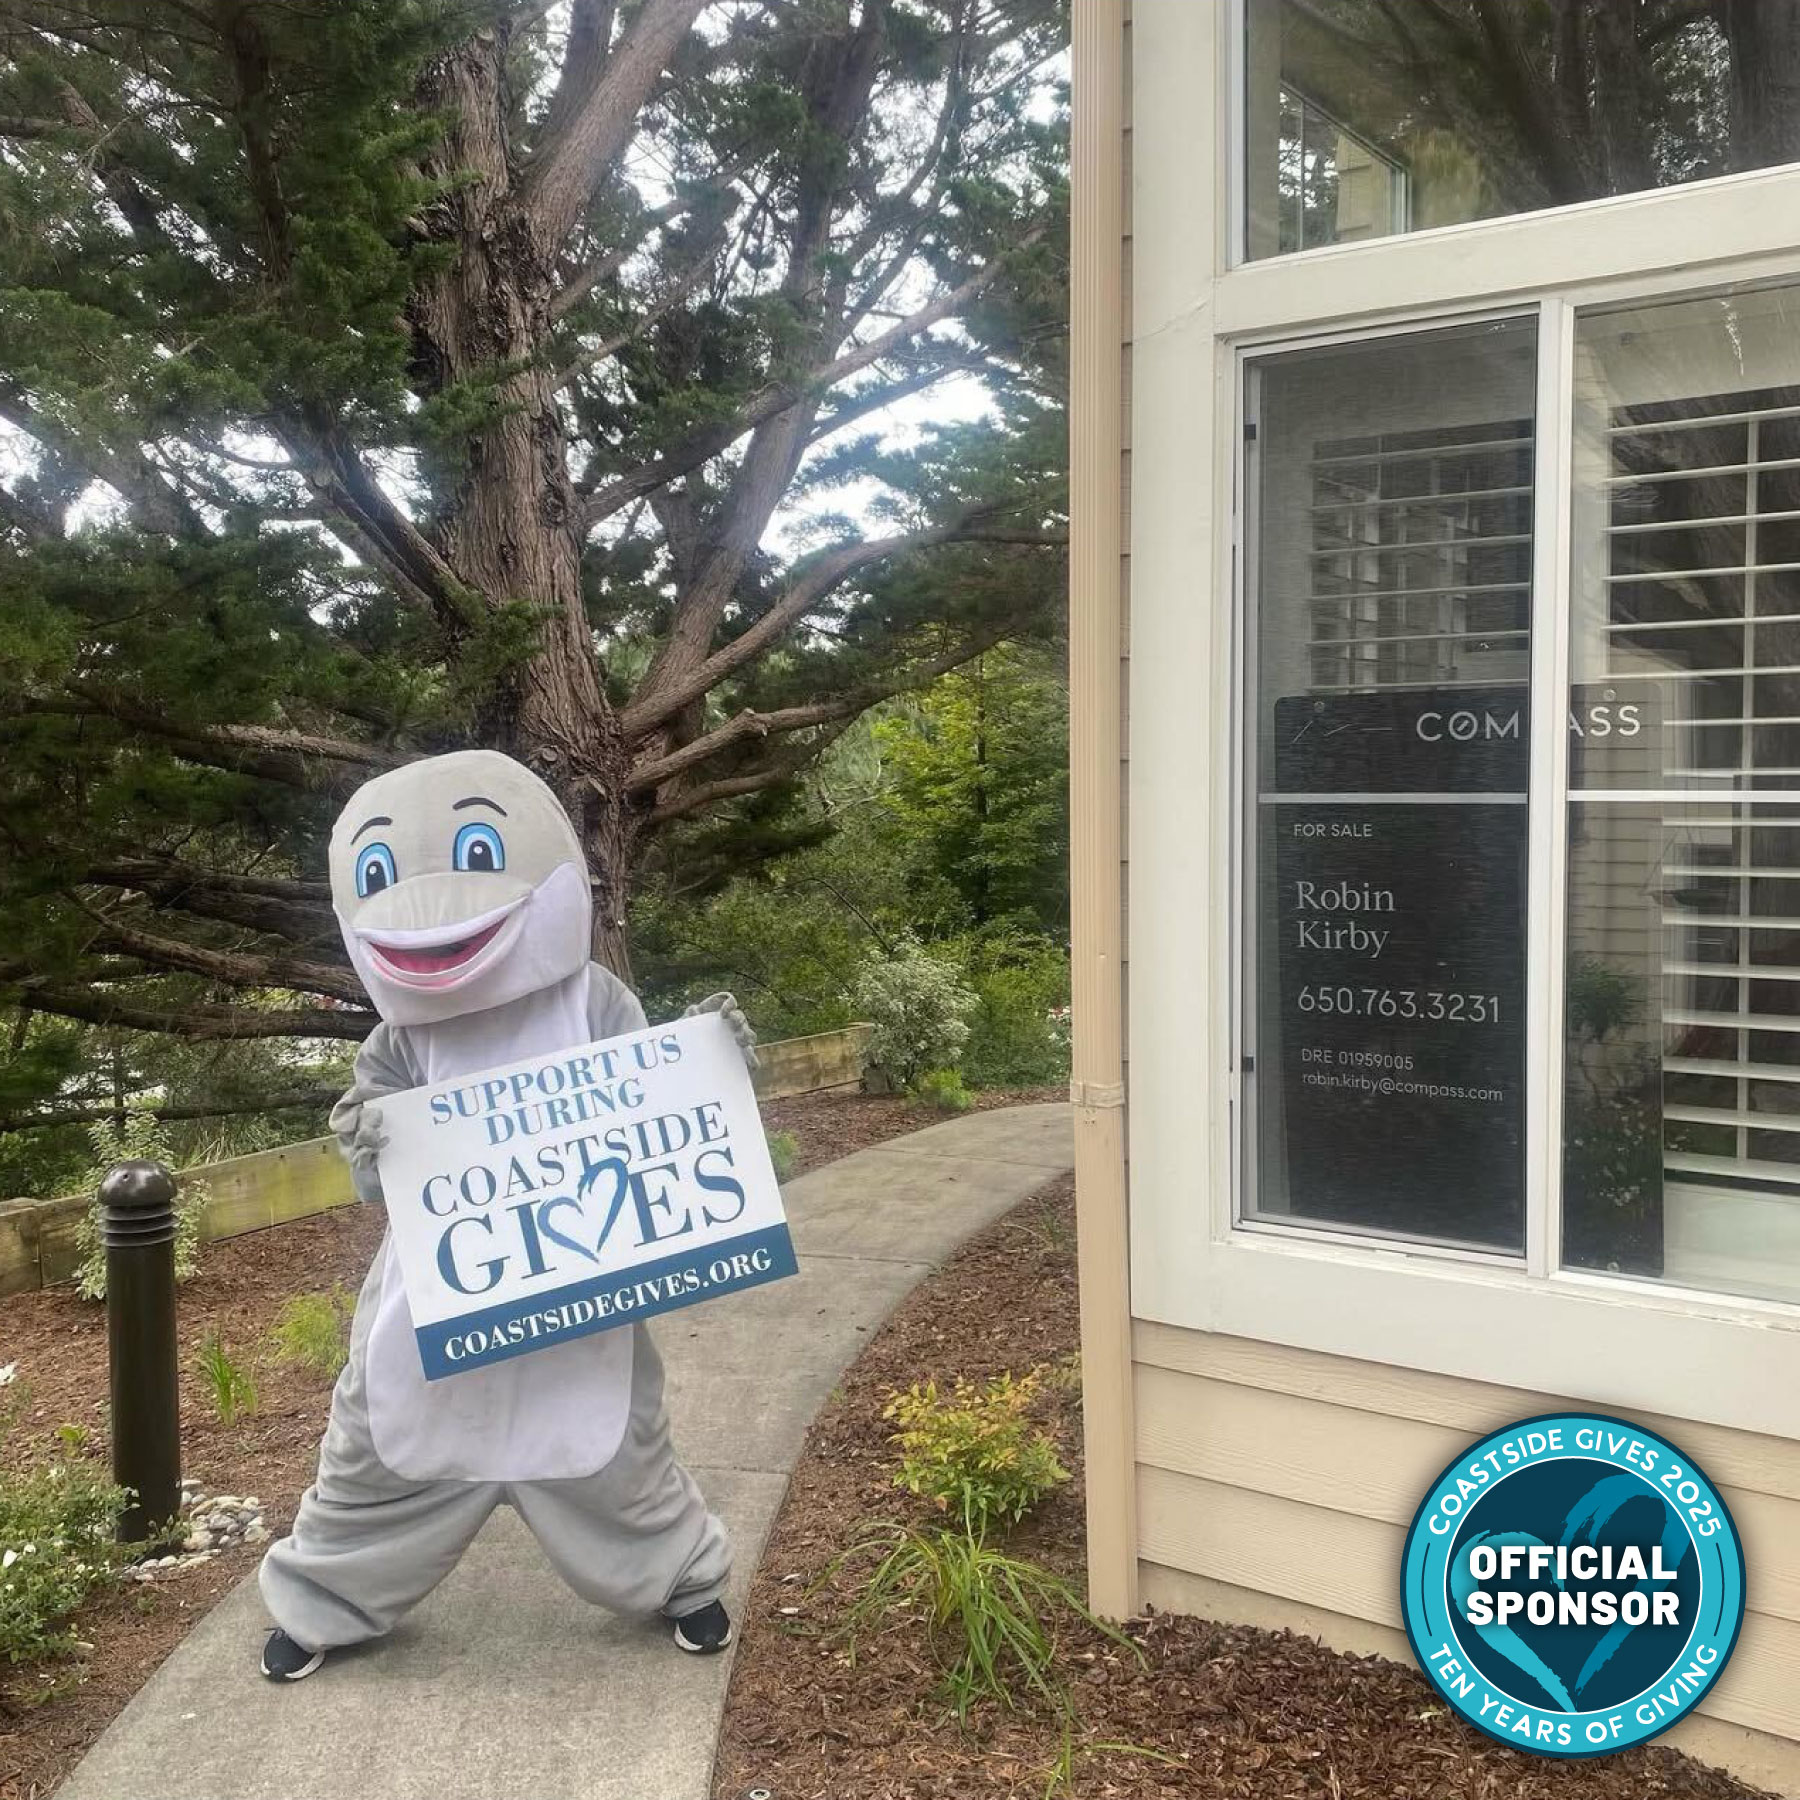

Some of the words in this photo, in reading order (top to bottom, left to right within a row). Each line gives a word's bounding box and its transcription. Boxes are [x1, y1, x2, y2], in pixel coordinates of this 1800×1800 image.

[1294, 824, 1326, 837] FOR
[1331, 824, 1373, 837] SALE
[1295, 881, 1395, 912] Robin
[1297, 921, 1389, 958] Kirby
[1299, 986, 1499, 1023] 650.763.3231
[1302, 1049, 1333, 1064] DRE
[1339, 1052, 1413, 1070] 01959005
[430, 1049, 619, 1126] SUPPORT
[632, 1034, 681, 1070] US
[1304, 1071, 1503, 1101] robin.kirby@compass.com
[483, 1078, 645, 1145] DURING
[422, 1101, 729, 1216] COASTSIDE
[445, 1248, 772, 1360] COASTSIDEGIVES.ORG
